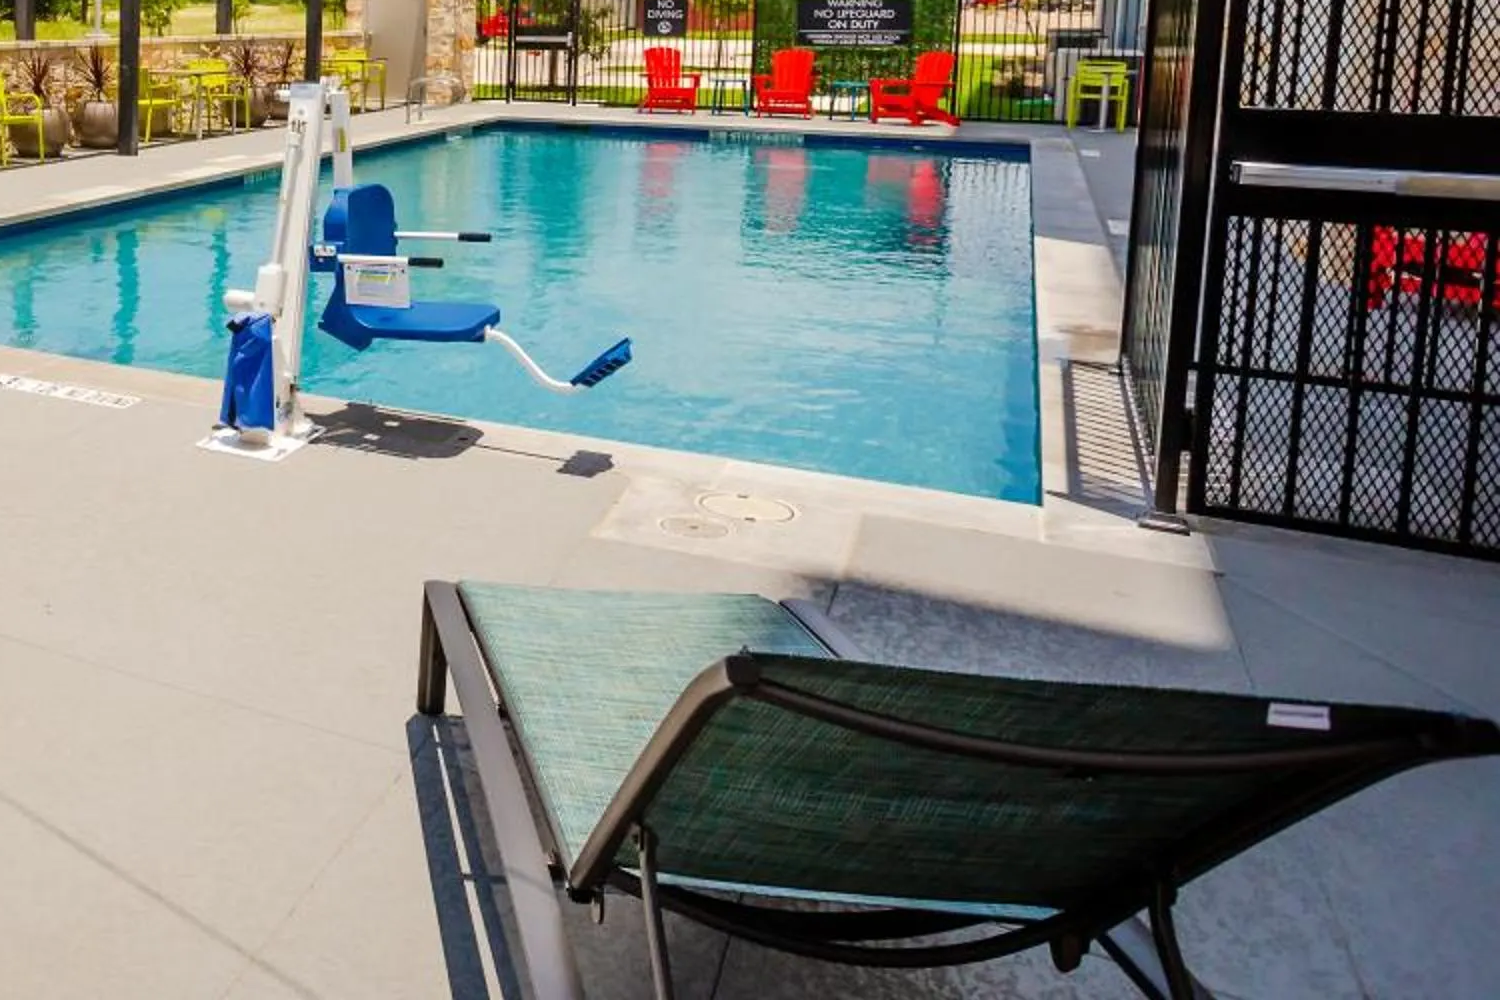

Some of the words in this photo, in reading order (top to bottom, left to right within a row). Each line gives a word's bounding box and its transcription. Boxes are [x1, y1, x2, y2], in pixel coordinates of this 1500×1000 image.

[657, 0, 675, 9] NO
[647, 9, 684, 20] DIVING
[813, 9, 834, 19] NO
[837, 9, 896, 19] LIFEGUARD
[827, 19, 847, 29] ON
[850, 19, 880, 29] DUTY
